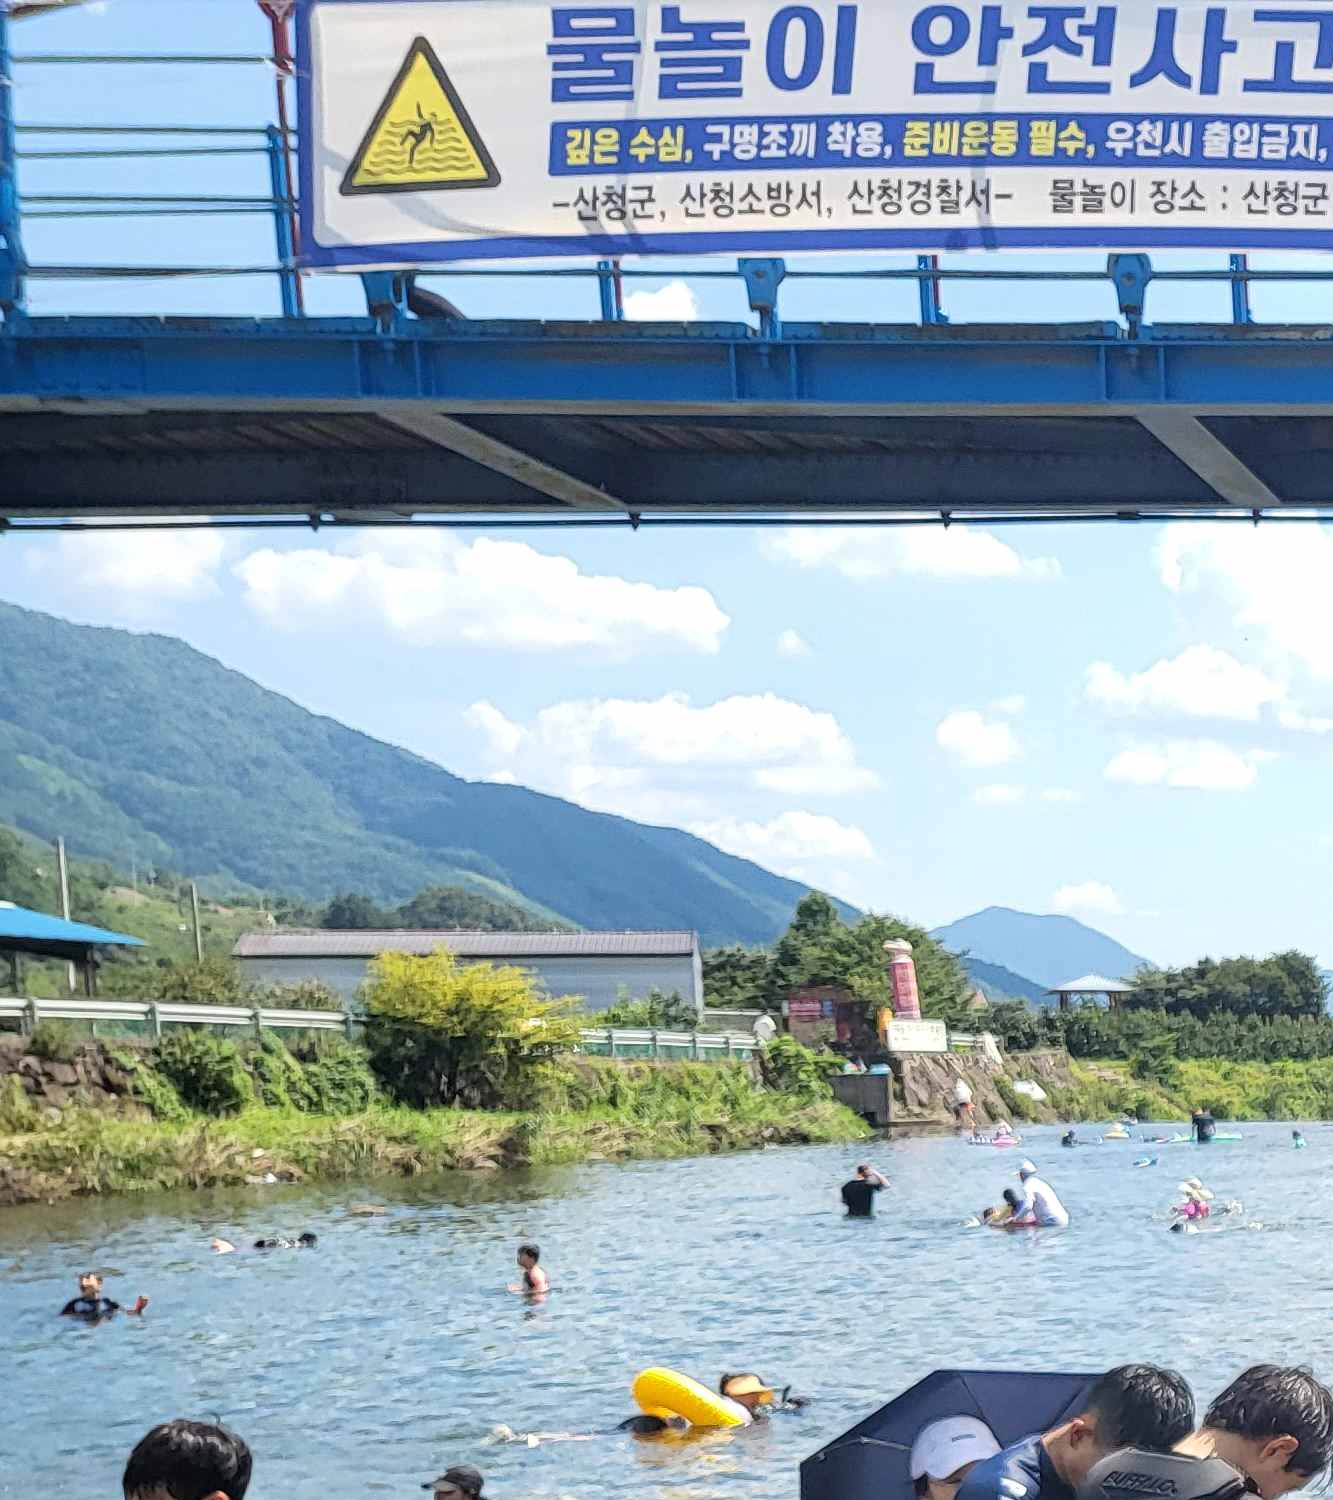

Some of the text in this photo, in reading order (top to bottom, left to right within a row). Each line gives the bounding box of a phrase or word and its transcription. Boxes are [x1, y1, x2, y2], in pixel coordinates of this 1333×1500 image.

[547, 5, 857, 102] 물놀이
[566, 127, 620, 165] 깊은
[628, 125, 692, 163] 수심,
[703, 121, 817, 160] 구명조끼
[826, 120, 893, 160] 착용,
[903, 120, 1019, 158] 준비운동
[1029, 120, 1095, 159] 필수,
[1105, 120, 1193, 158] 우천시
[1202, 120, 1327, 163] 출입금지,
[679, 180, 833, 218] 산청소방서,
[1050, 178, 1136, 215] 물놀이
[1150, 179, 1206, 215] 장소
[1242, 180, 1329, 216] 산청군
